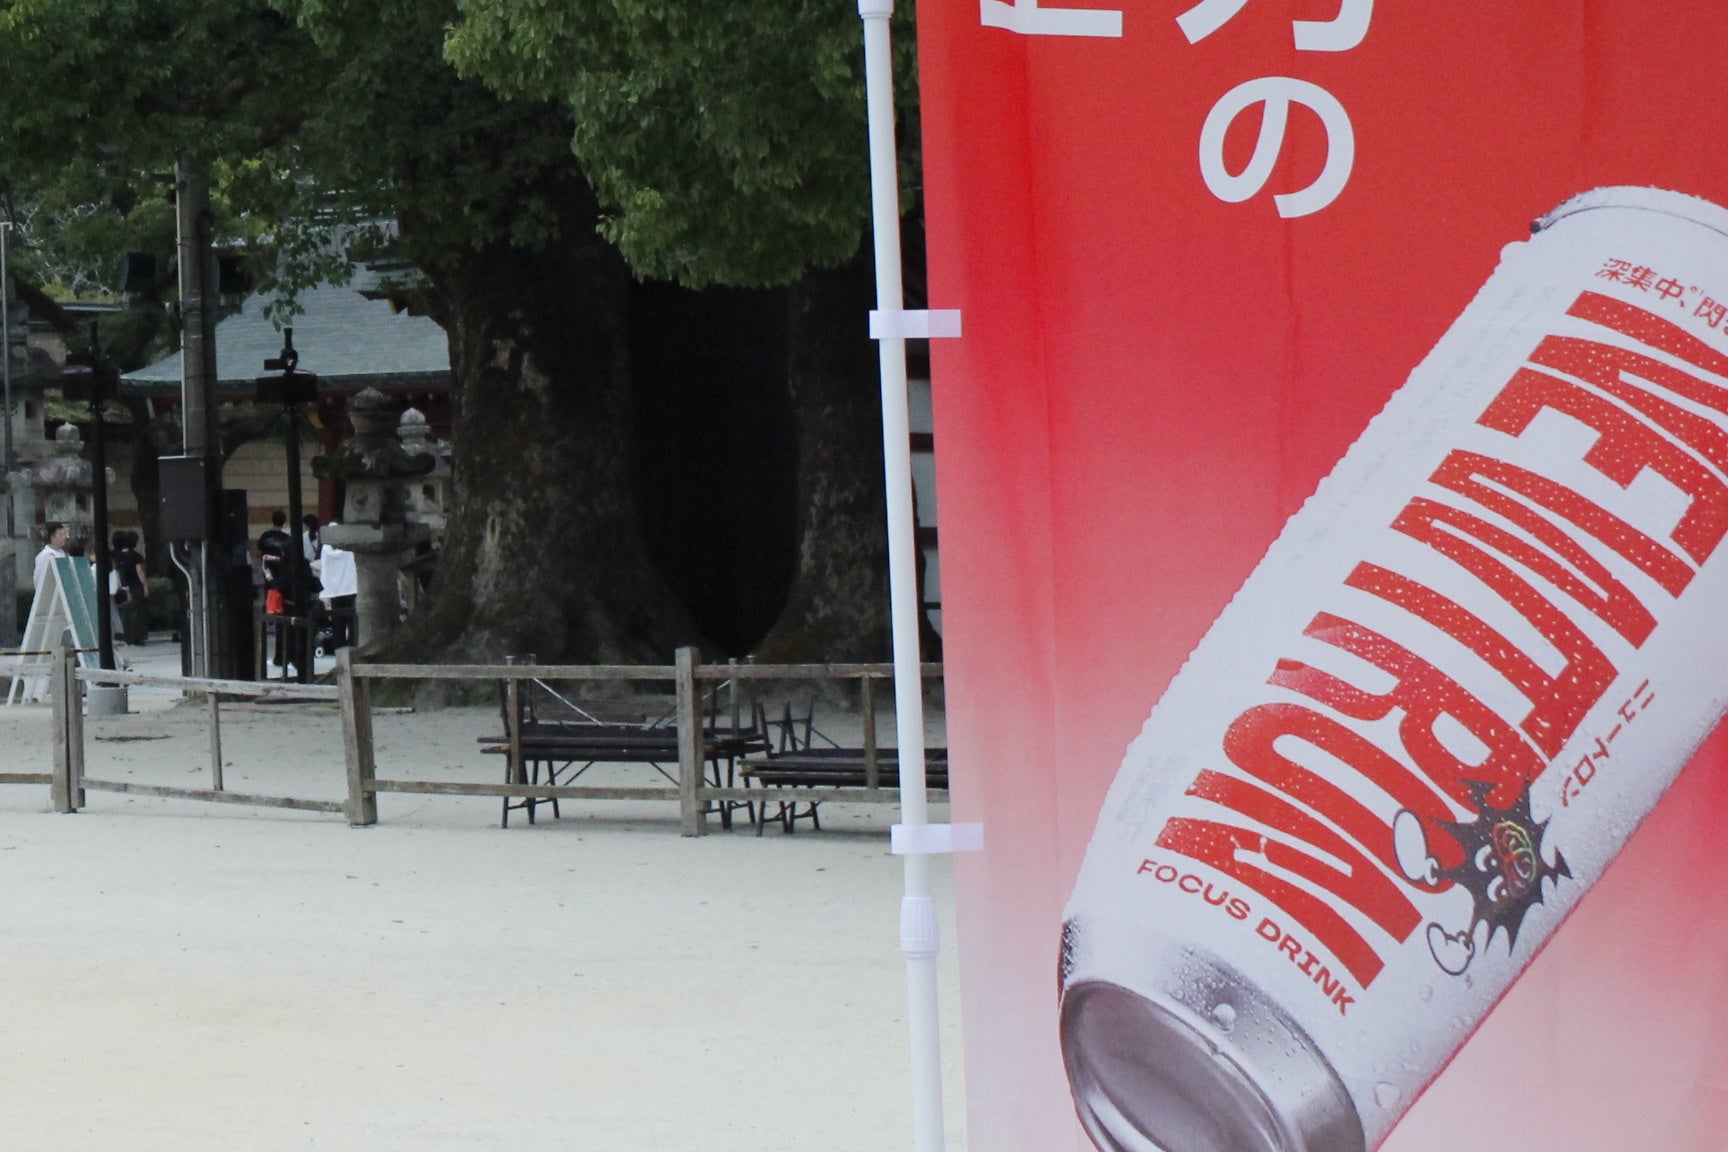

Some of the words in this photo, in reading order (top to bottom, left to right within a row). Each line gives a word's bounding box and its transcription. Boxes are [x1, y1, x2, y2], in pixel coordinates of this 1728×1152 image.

[1154, 289, 1728, 991] NEWTRON
[1560, 678, 1655, 808] ニュートロン
[1136, 858, 1251, 921] FOCUS
[1255, 917, 1356, 1017] DRINK
